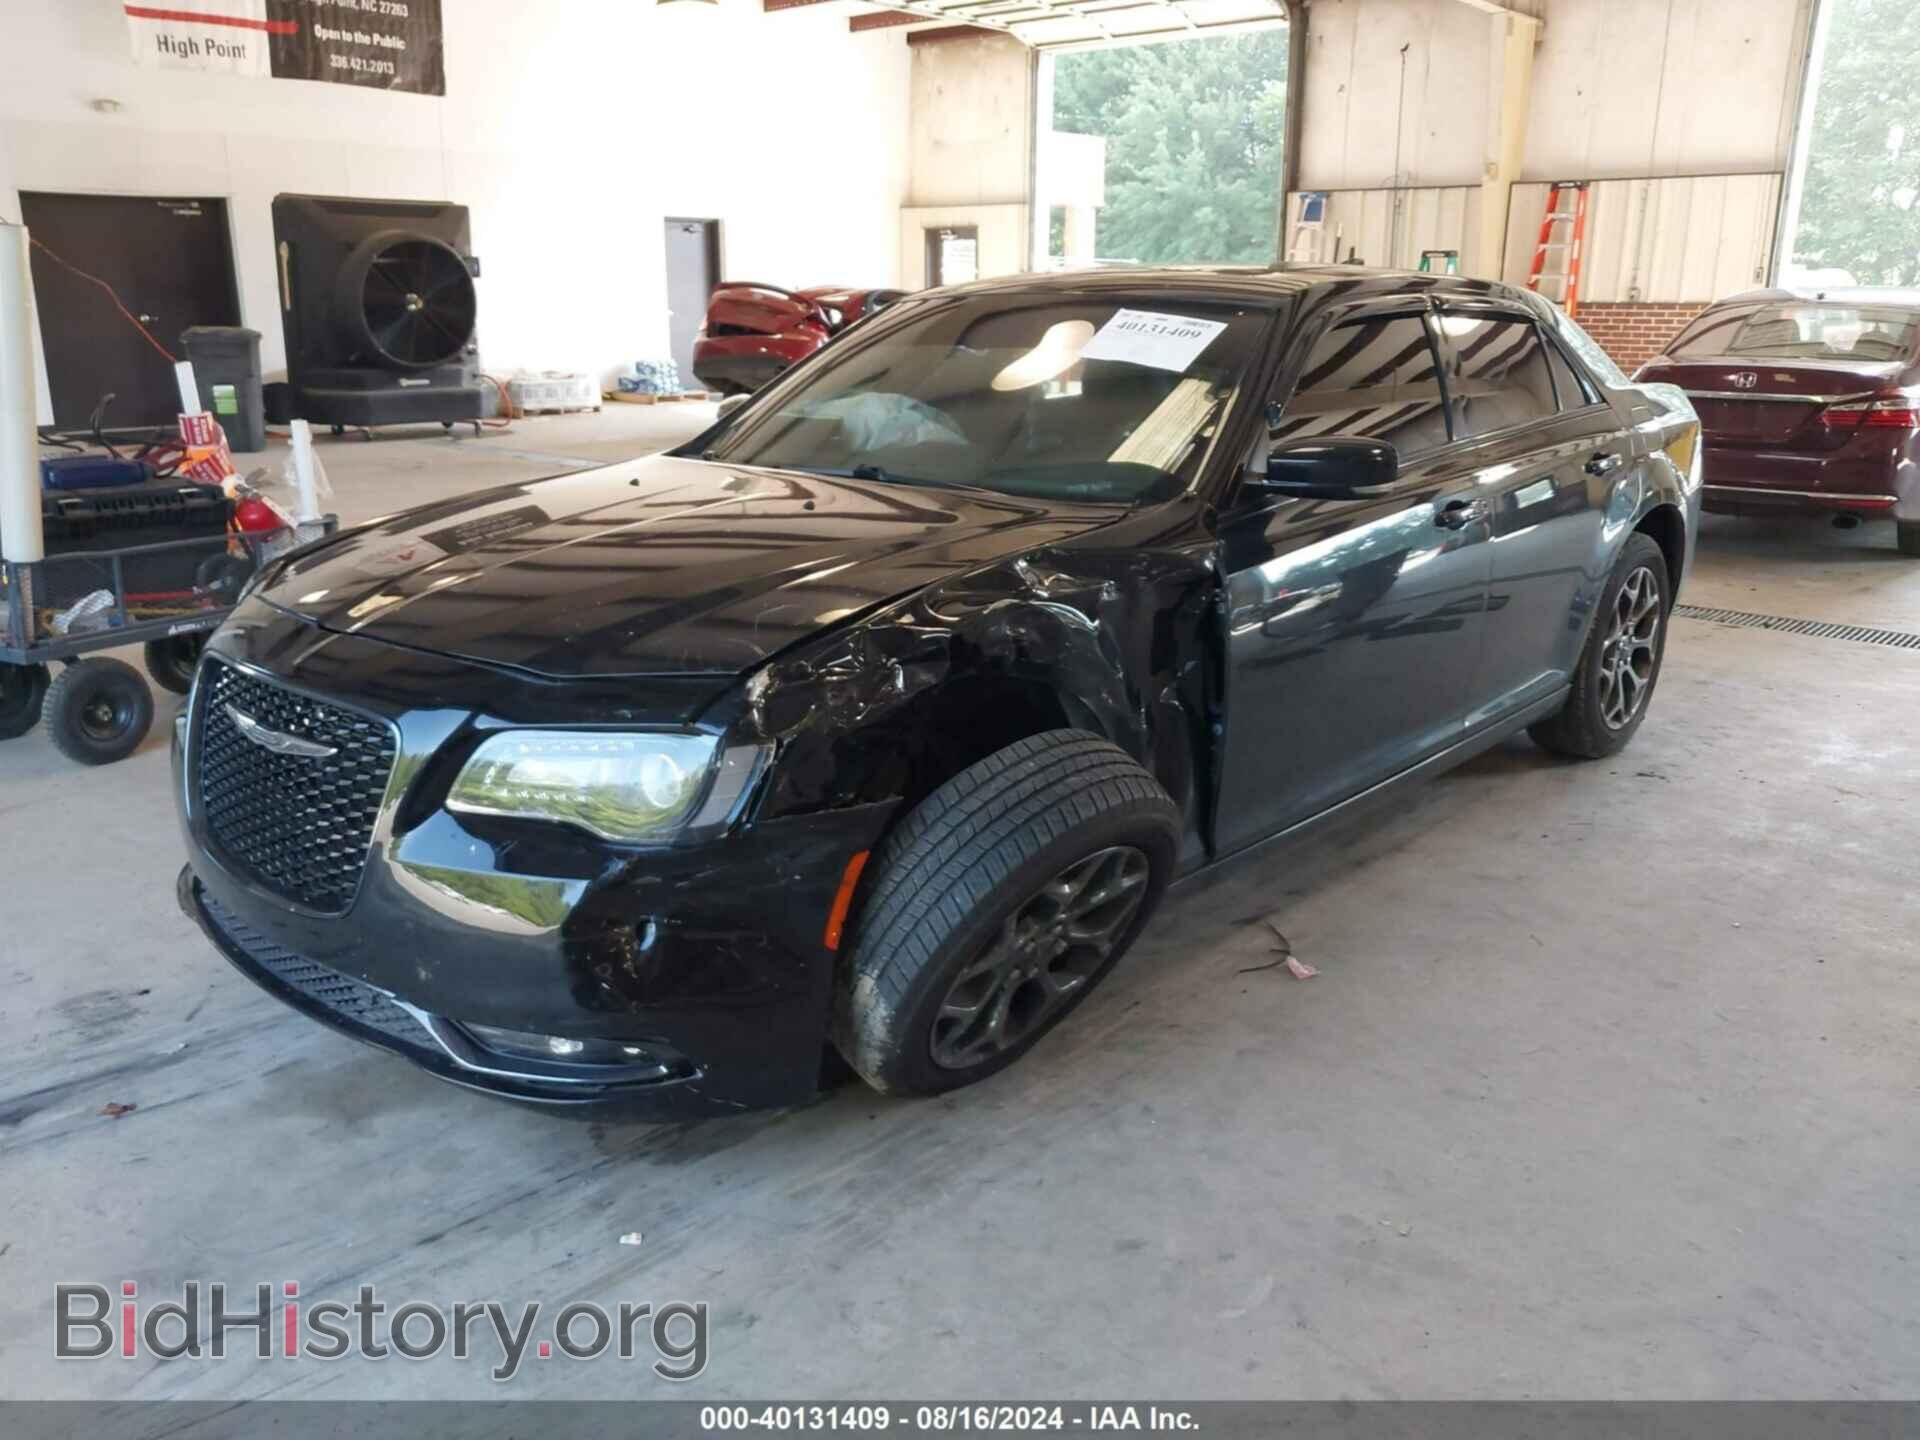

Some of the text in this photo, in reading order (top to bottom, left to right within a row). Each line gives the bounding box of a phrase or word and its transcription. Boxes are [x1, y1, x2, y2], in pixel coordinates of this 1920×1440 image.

[156, 34, 247, 59] High Point
[314, 23, 406, 50] Open to the Public
[1117, 320, 1203, 338] 40131409
